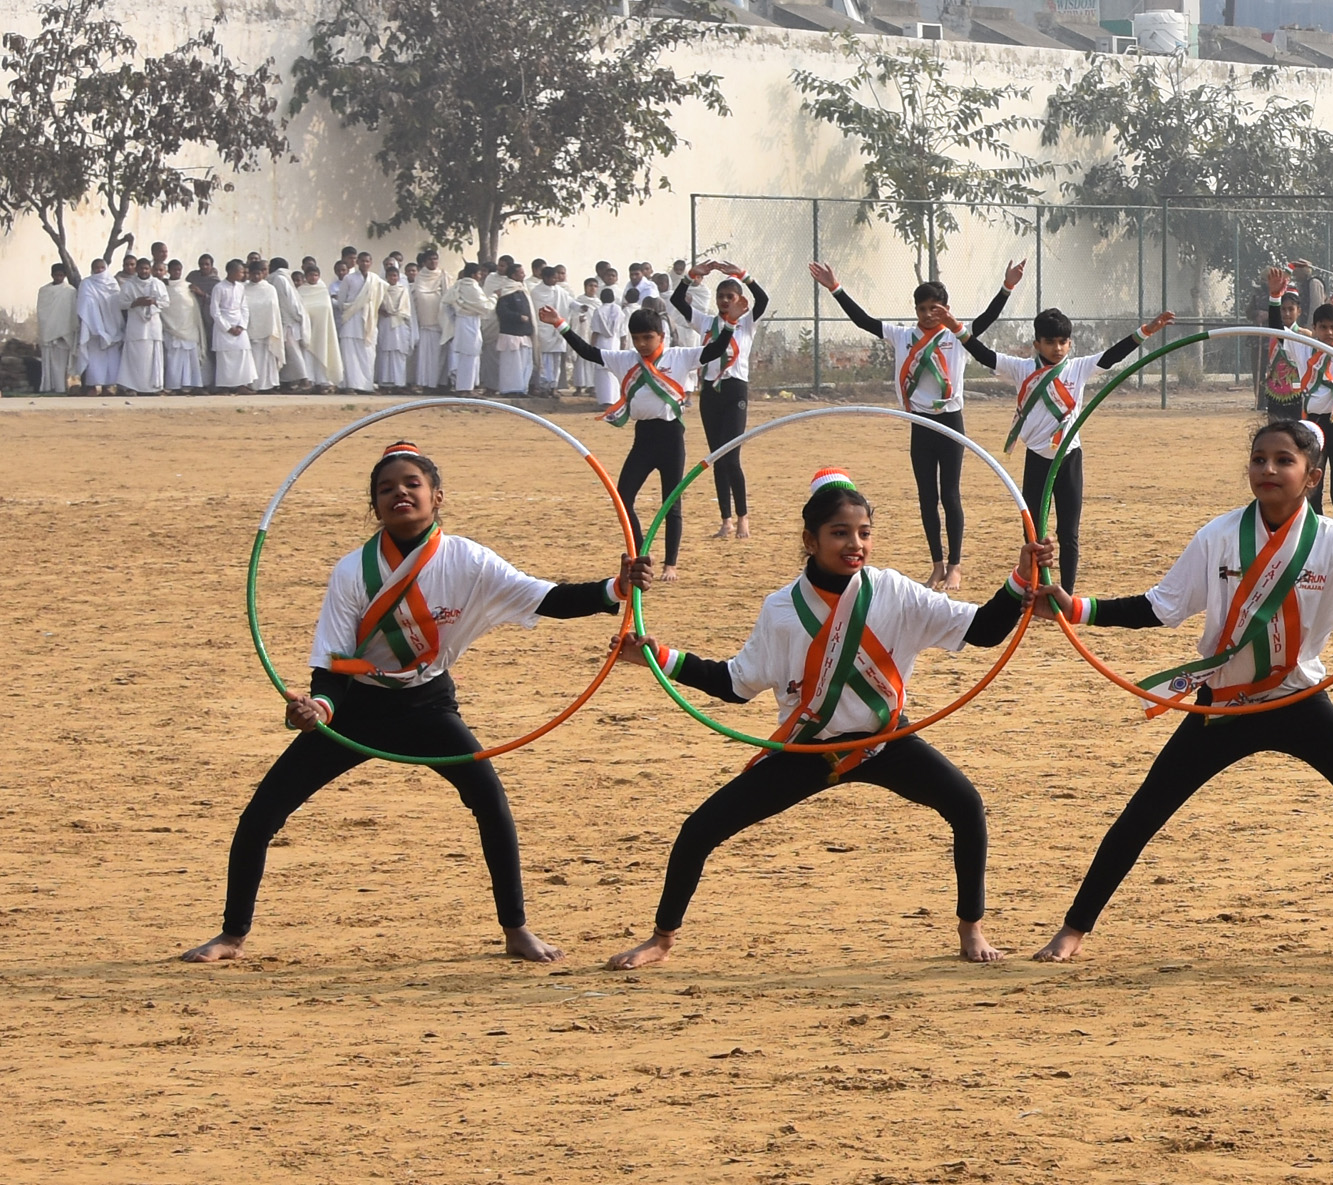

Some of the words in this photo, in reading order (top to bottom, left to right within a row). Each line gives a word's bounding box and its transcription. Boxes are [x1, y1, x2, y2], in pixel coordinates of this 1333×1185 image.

[1056, 0, 1095, 8] WISDOM
[1262, 560, 1281, 588] JAI
[1308, 574, 1327, 584] RUN
[1238, 591, 1262, 628] HIND
[402, 618, 424, 652] HIND
[831, 621, 843, 653] JAI
[1271, 612, 1282, 653] HIND
[815, 657, 833, 697] HIND
